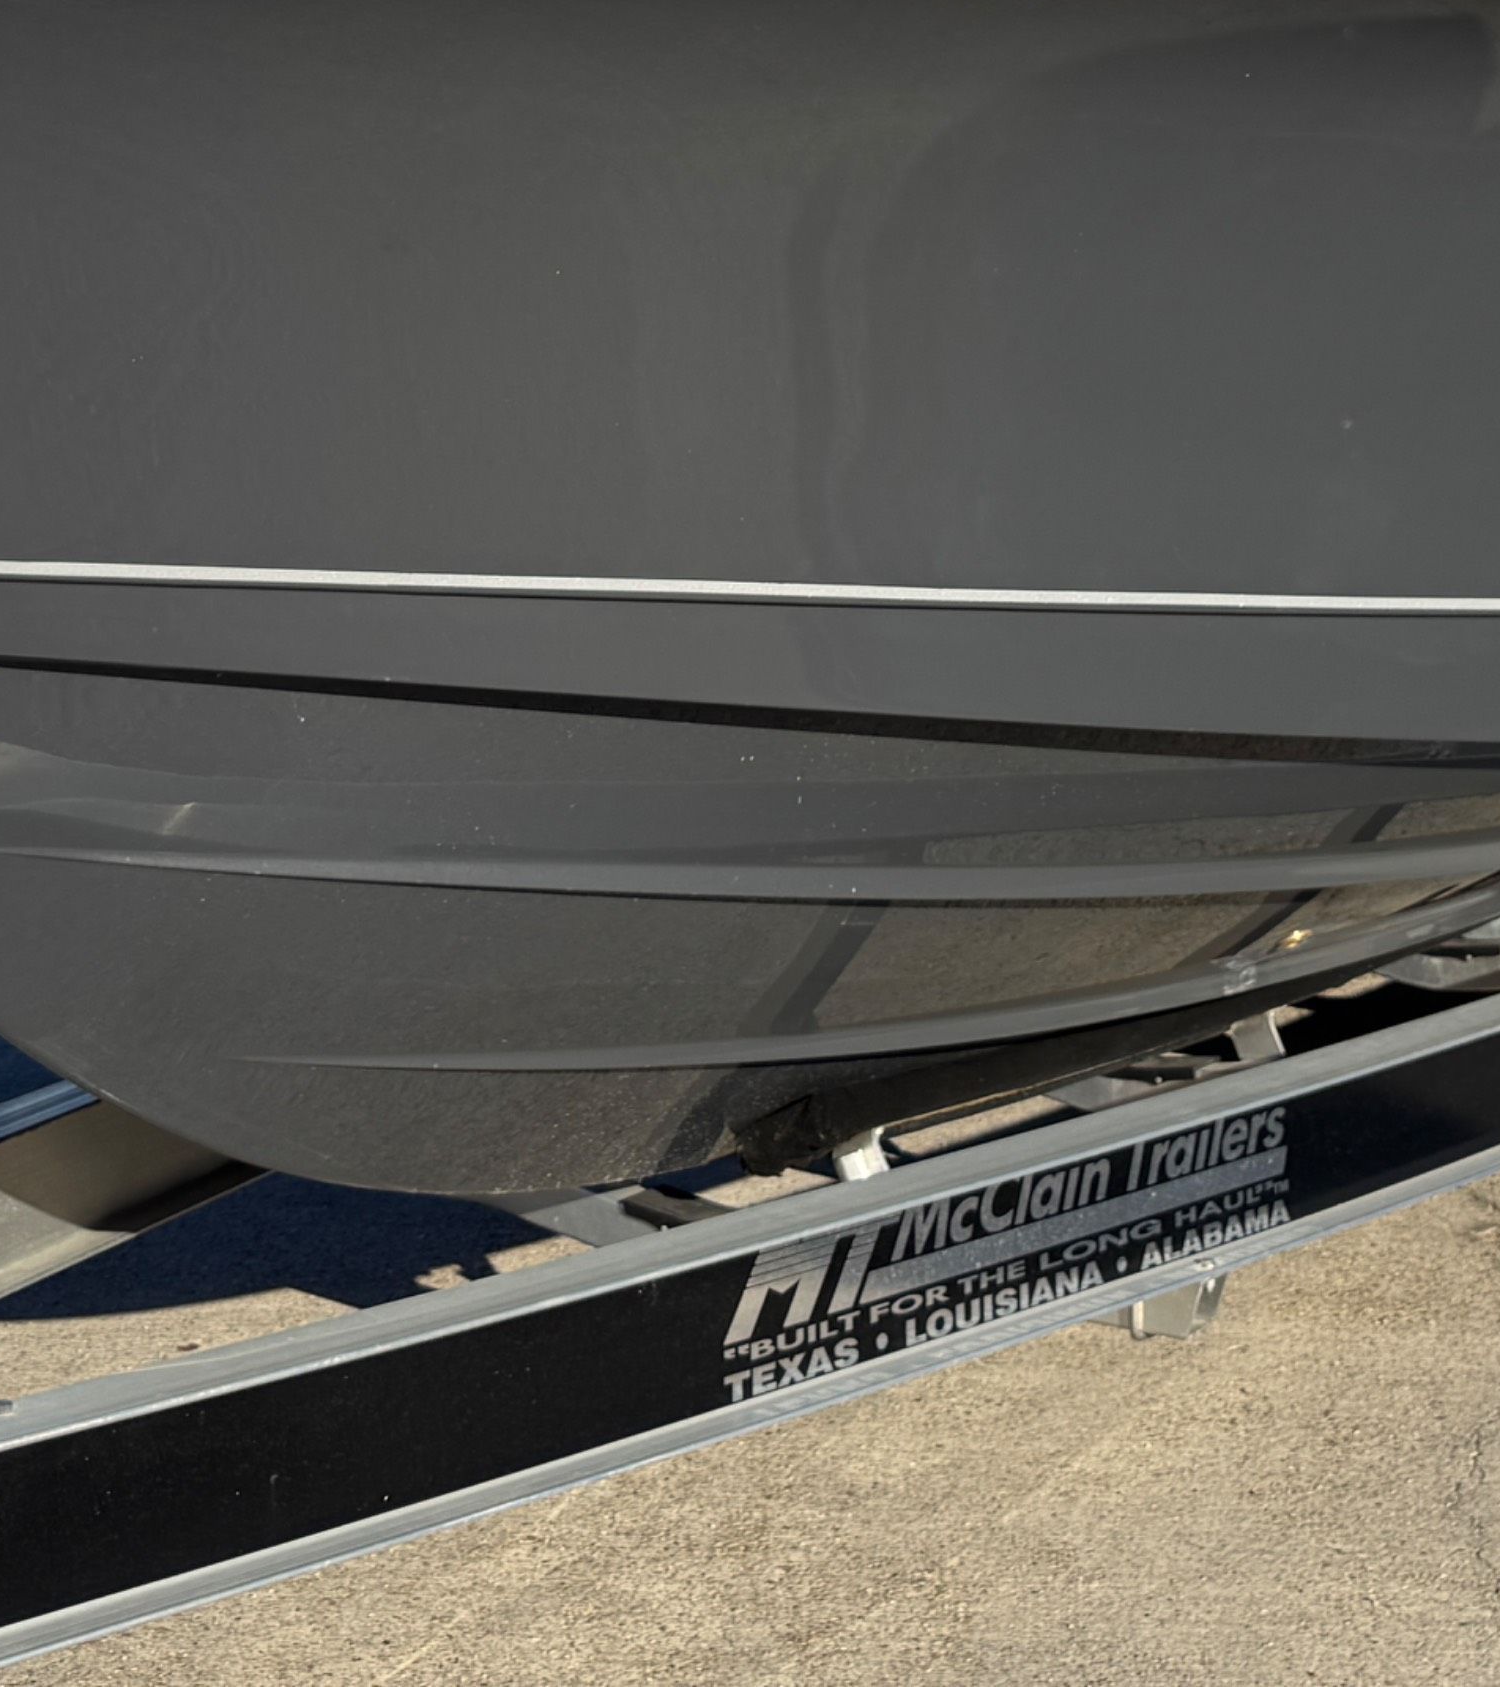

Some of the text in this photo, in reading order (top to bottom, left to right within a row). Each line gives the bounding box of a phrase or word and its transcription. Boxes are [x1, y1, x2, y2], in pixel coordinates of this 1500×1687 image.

[891, 1107, 1286, 1262] McClain Trailers
[723, 1199, 1292, 1403] TEXAS LOUISIANA ALABAMA
[869, 1285, 951, 1325] FOR
[957, 1261, 1027, 1296] THE
[1039, 1219, 1163, 1272] LONG
